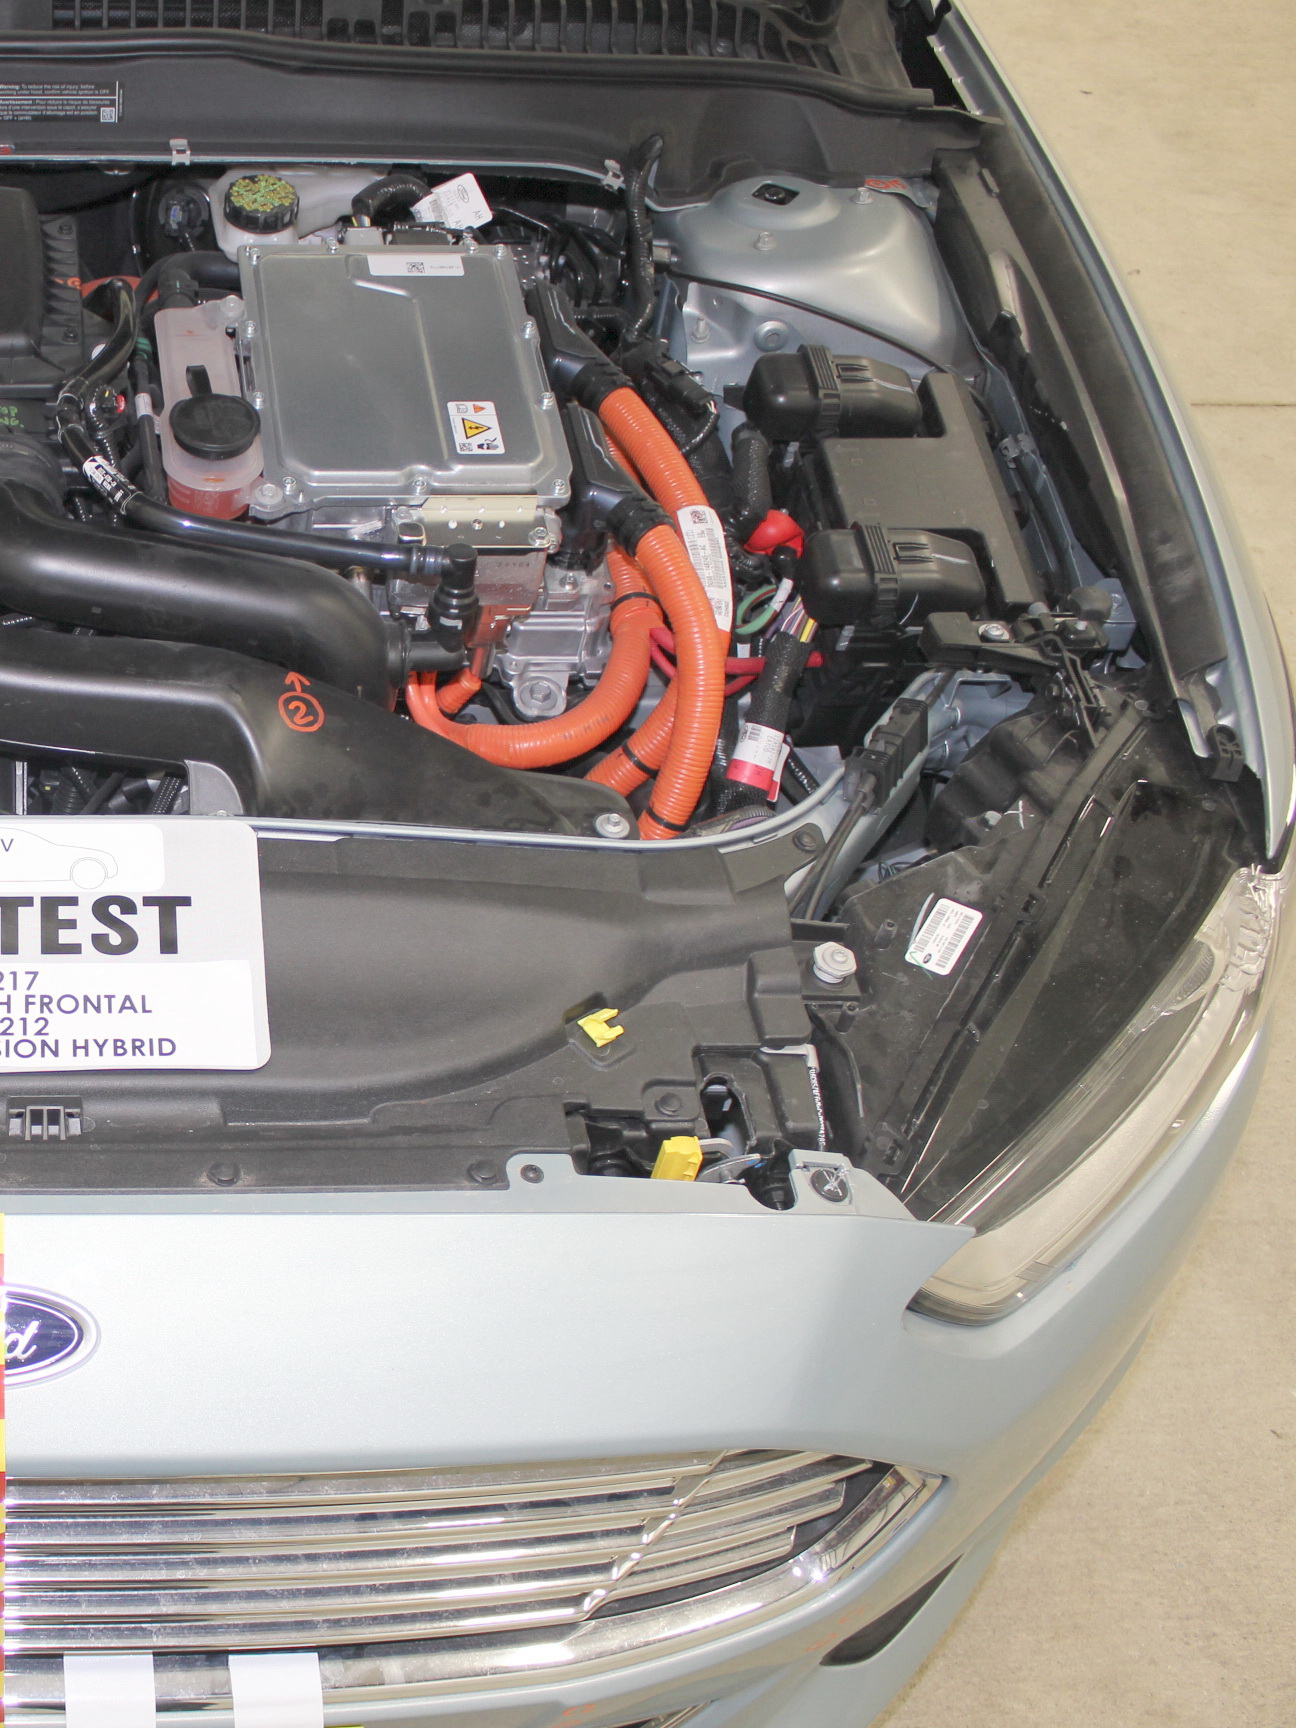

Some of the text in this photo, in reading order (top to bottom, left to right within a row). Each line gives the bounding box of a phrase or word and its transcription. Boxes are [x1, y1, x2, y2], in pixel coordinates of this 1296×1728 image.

[288, 700, 314, 724] 2
[24, 994, 153, 1014] FRONTAL
[72, 1038, 177, 1057] HYBRID
